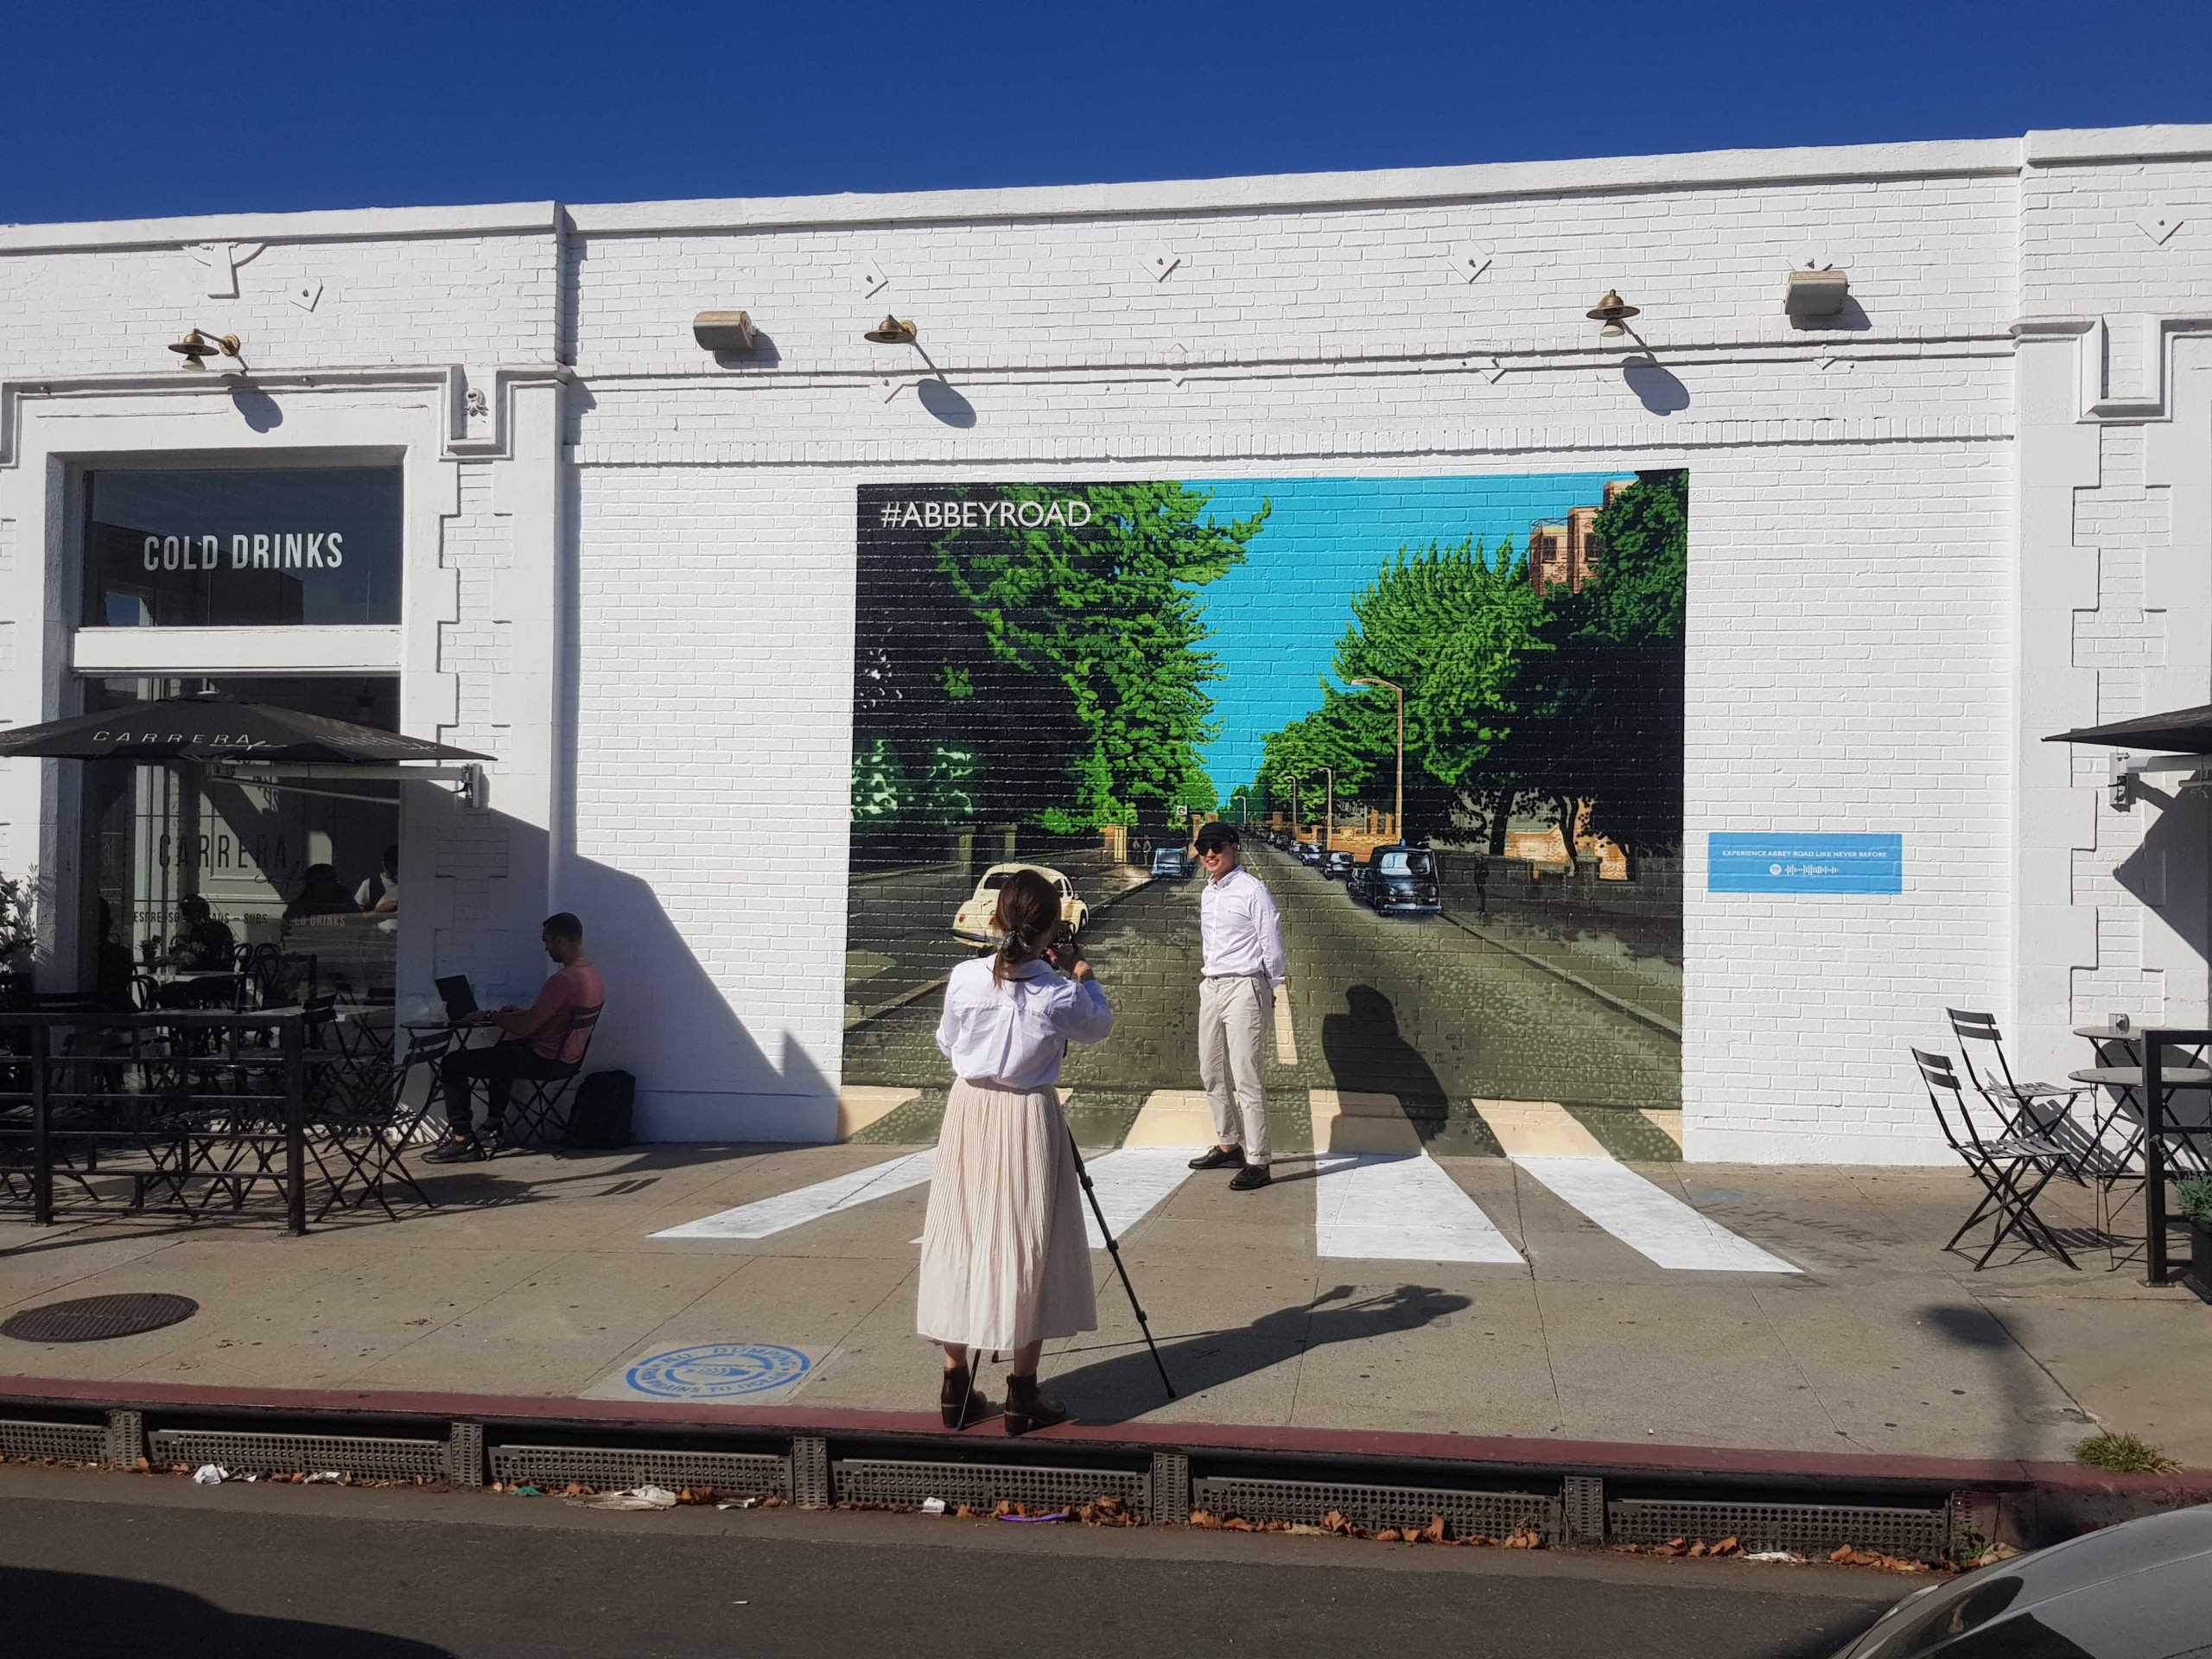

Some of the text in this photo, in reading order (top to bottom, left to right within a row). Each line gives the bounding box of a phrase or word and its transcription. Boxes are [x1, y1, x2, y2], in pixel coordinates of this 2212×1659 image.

[880, 500, 1091, 529] #ABBEYROAD
[143, 532, 343, 571] COLD DRINKS
[92, 731, 250, 744] CARRERA
[159, 833, 286, 868] CARRERA
[309, 914, 346, 927] DRINKS
[659, 1346, 797, 1367] NO DUMPING
